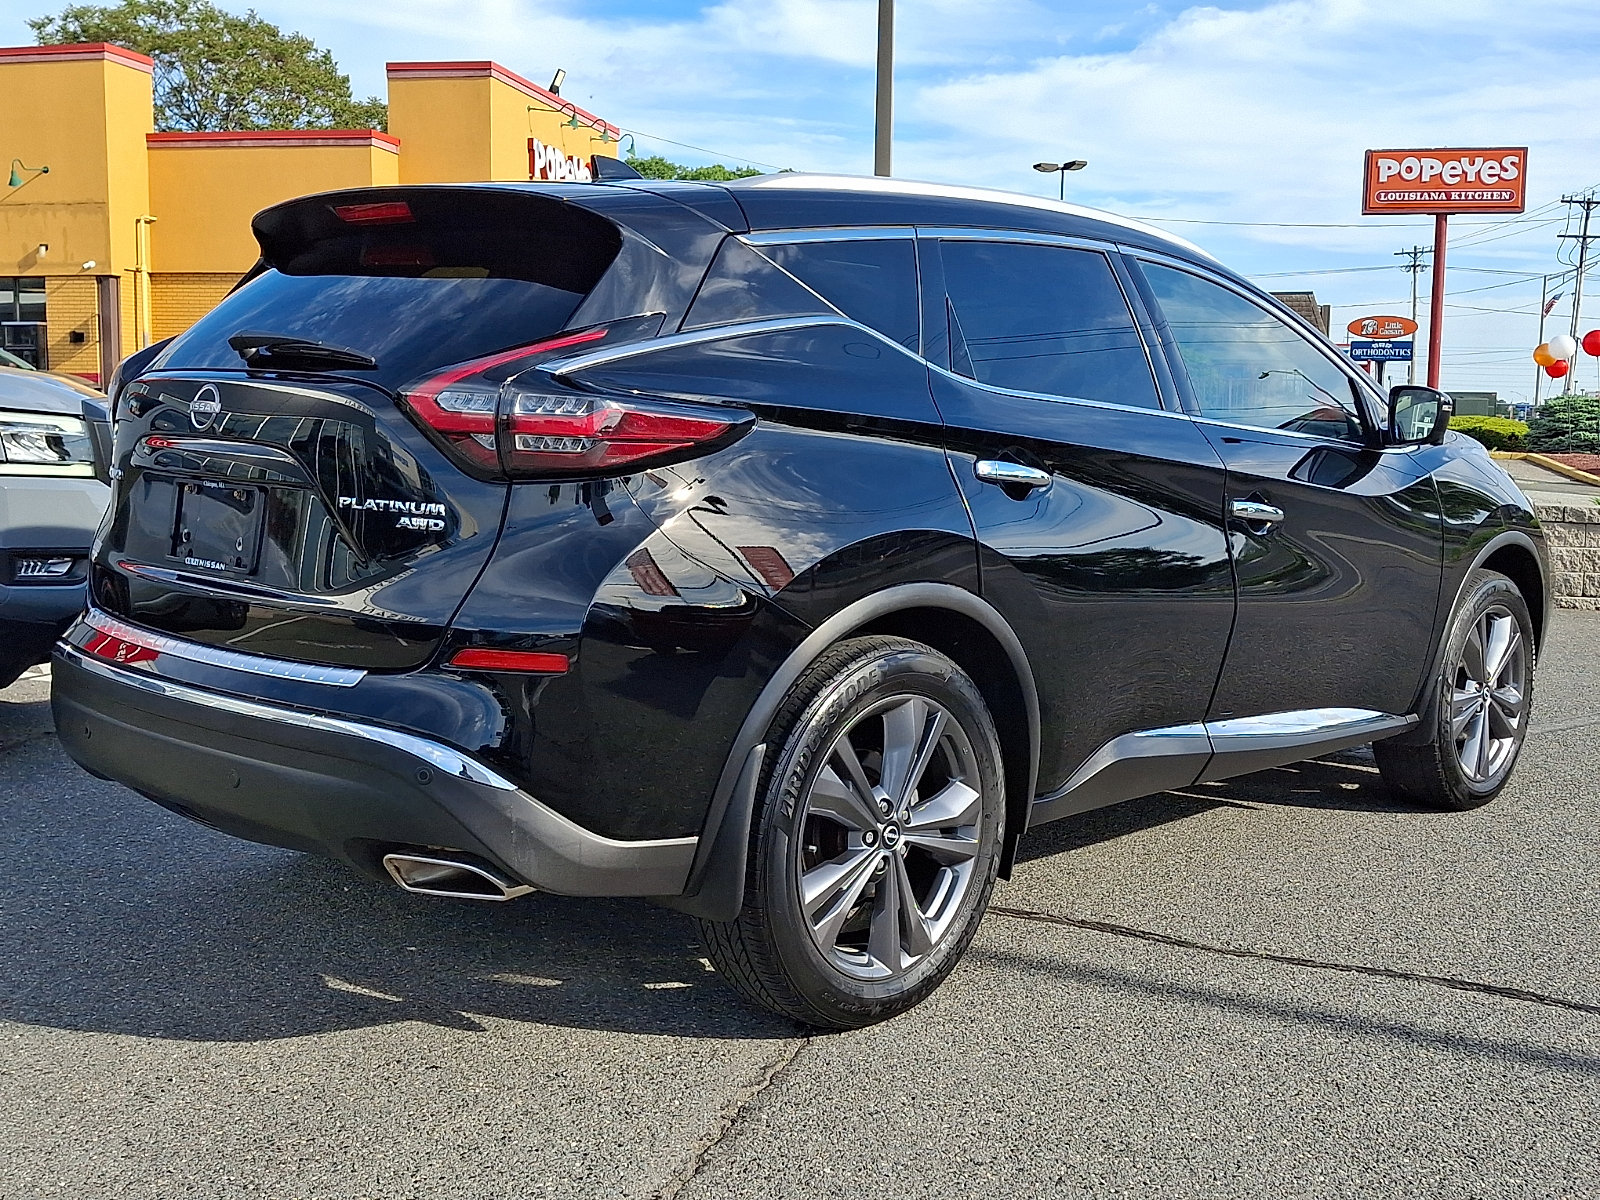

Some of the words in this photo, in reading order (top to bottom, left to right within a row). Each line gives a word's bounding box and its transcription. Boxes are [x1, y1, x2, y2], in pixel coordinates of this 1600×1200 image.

[1380, 191, 1447, 201] LOUISIANA
[1451, 191, 1512, 200] KITCHEN
[1385, 321, 1403, 329] Little
[1352, 348, 1411, 356] ORTHODONTICS
[339, 496, 446, 516] PLATINUM
[395, 516, 445, 531] AWD
[199, 559, 226, 571] NISSAN
